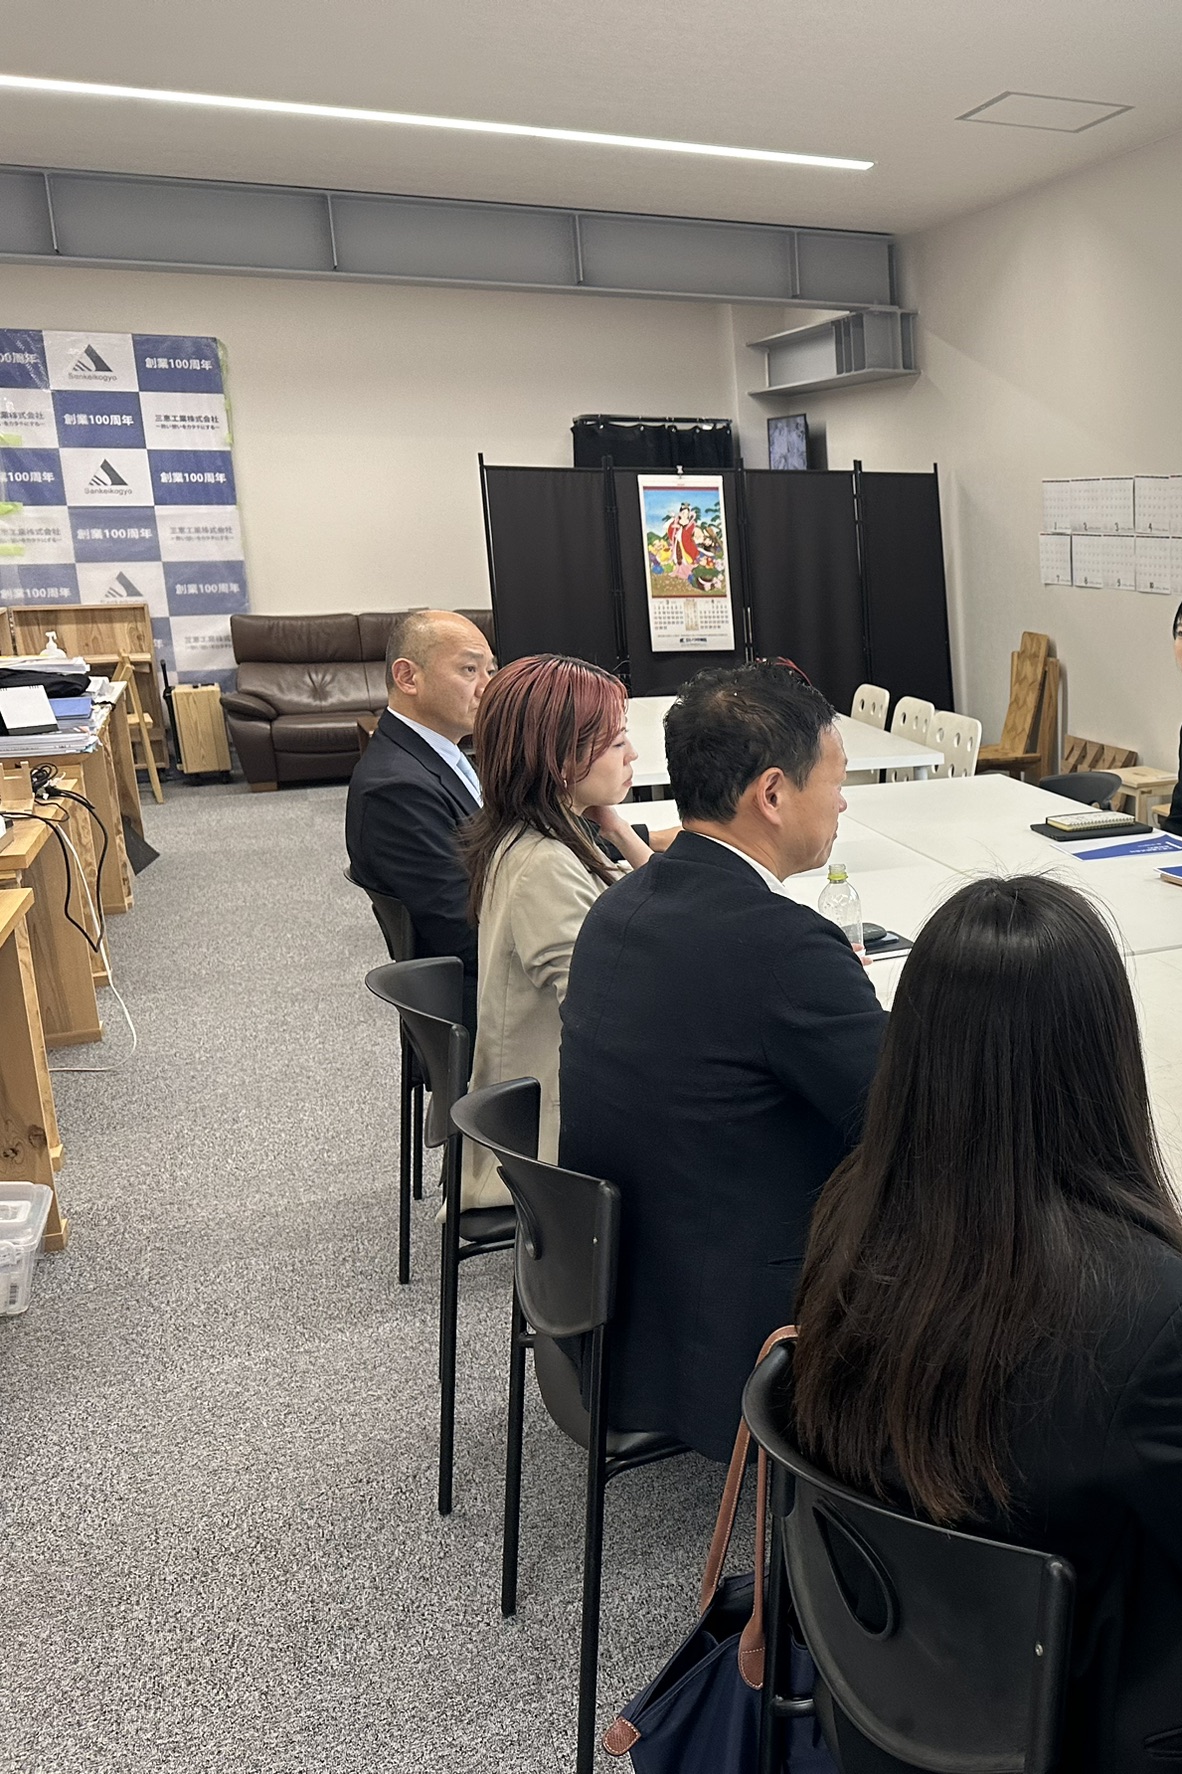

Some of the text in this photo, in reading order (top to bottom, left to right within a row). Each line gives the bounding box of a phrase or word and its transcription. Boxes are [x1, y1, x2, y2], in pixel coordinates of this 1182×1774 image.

[145, 357, 213, 370] 創業100周年
[64, 413, 134, 426] 創業100周年
[160, 472, 227, 484] 創業100周年
[84, 487, 133, 495] Sankeikogyo
[77, 528, 153, 540] 創業100周年
[175, 583, 240, 596] 創業100周年
